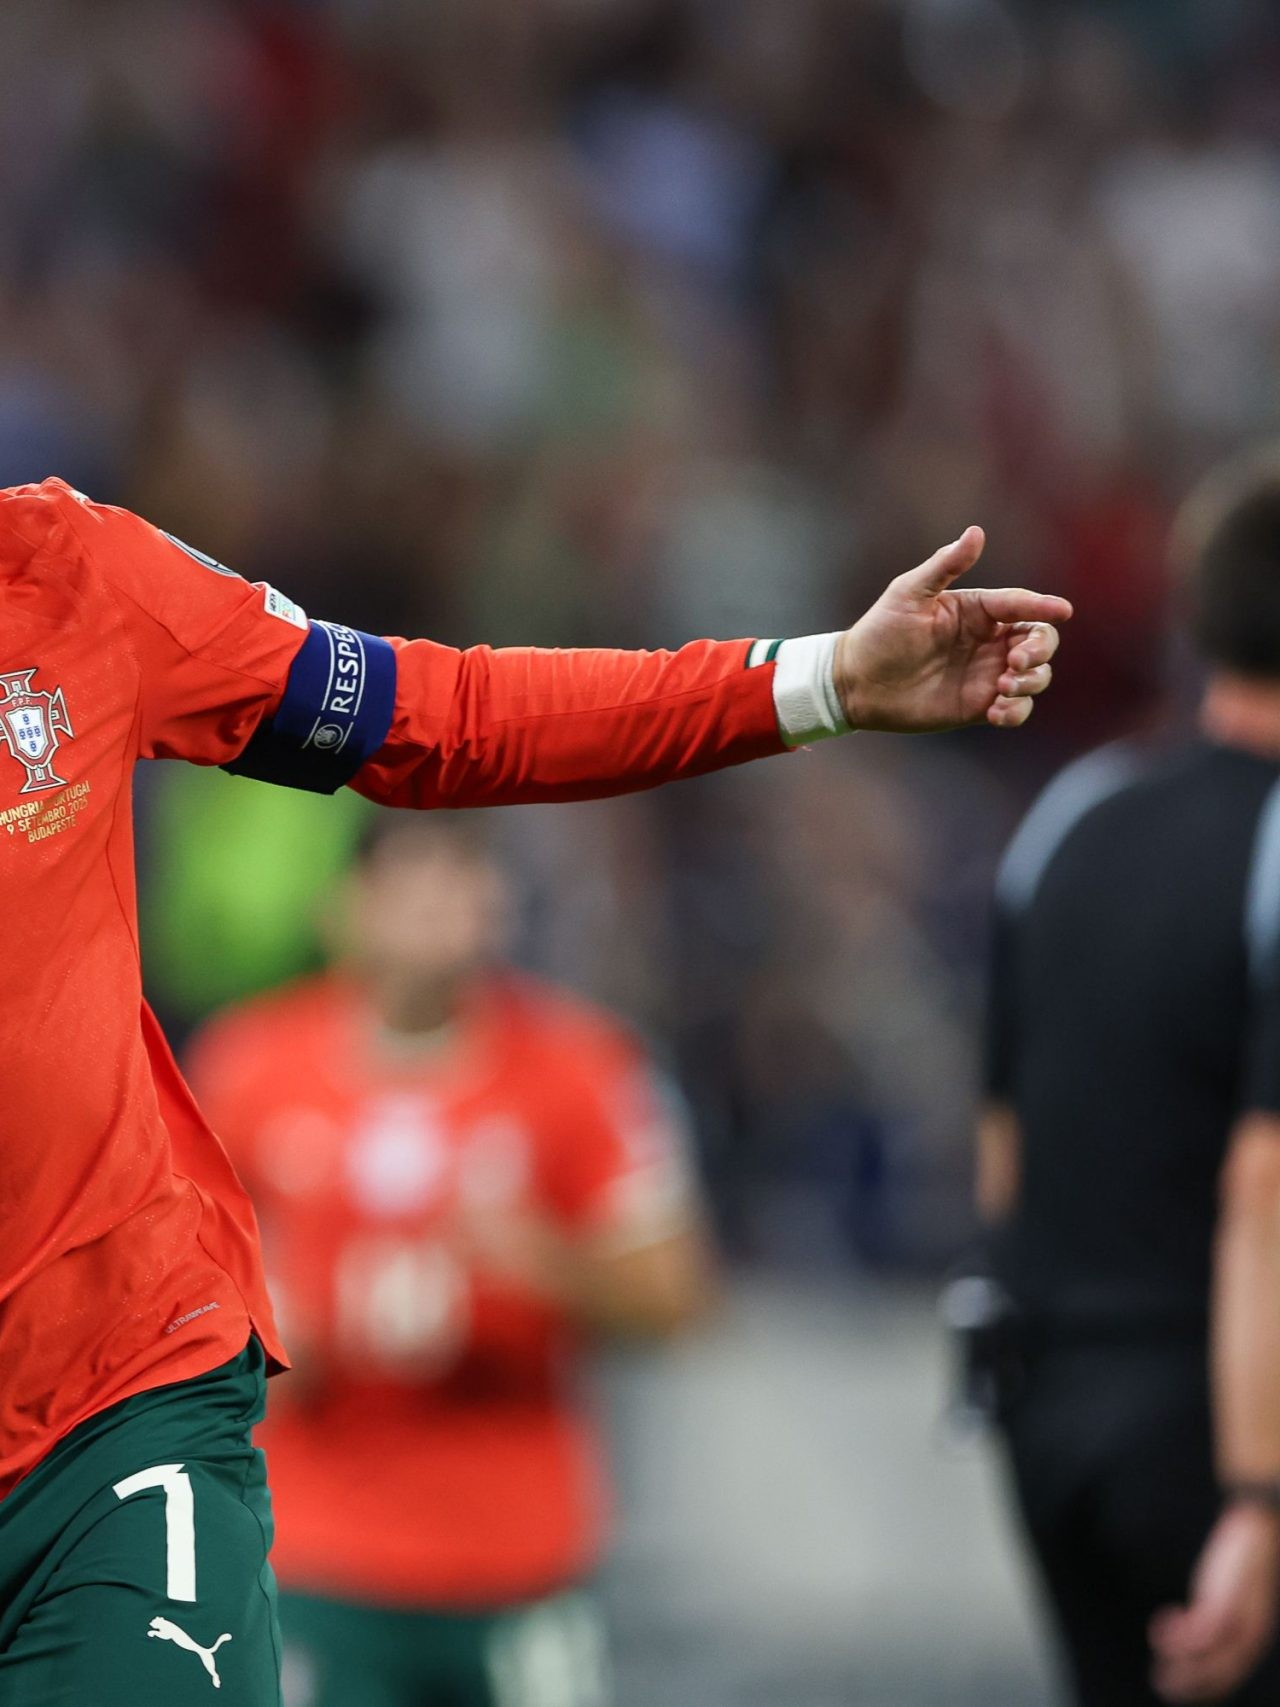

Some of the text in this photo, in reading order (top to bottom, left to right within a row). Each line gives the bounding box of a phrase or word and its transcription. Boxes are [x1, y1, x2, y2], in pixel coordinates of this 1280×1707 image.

[328, 622, 360, 714] RESPEC
[6, 824, 15, 835] 9
[27, 815, 76, 843] BUDAPESTE
[111, 1463, 197, 1603] 7
